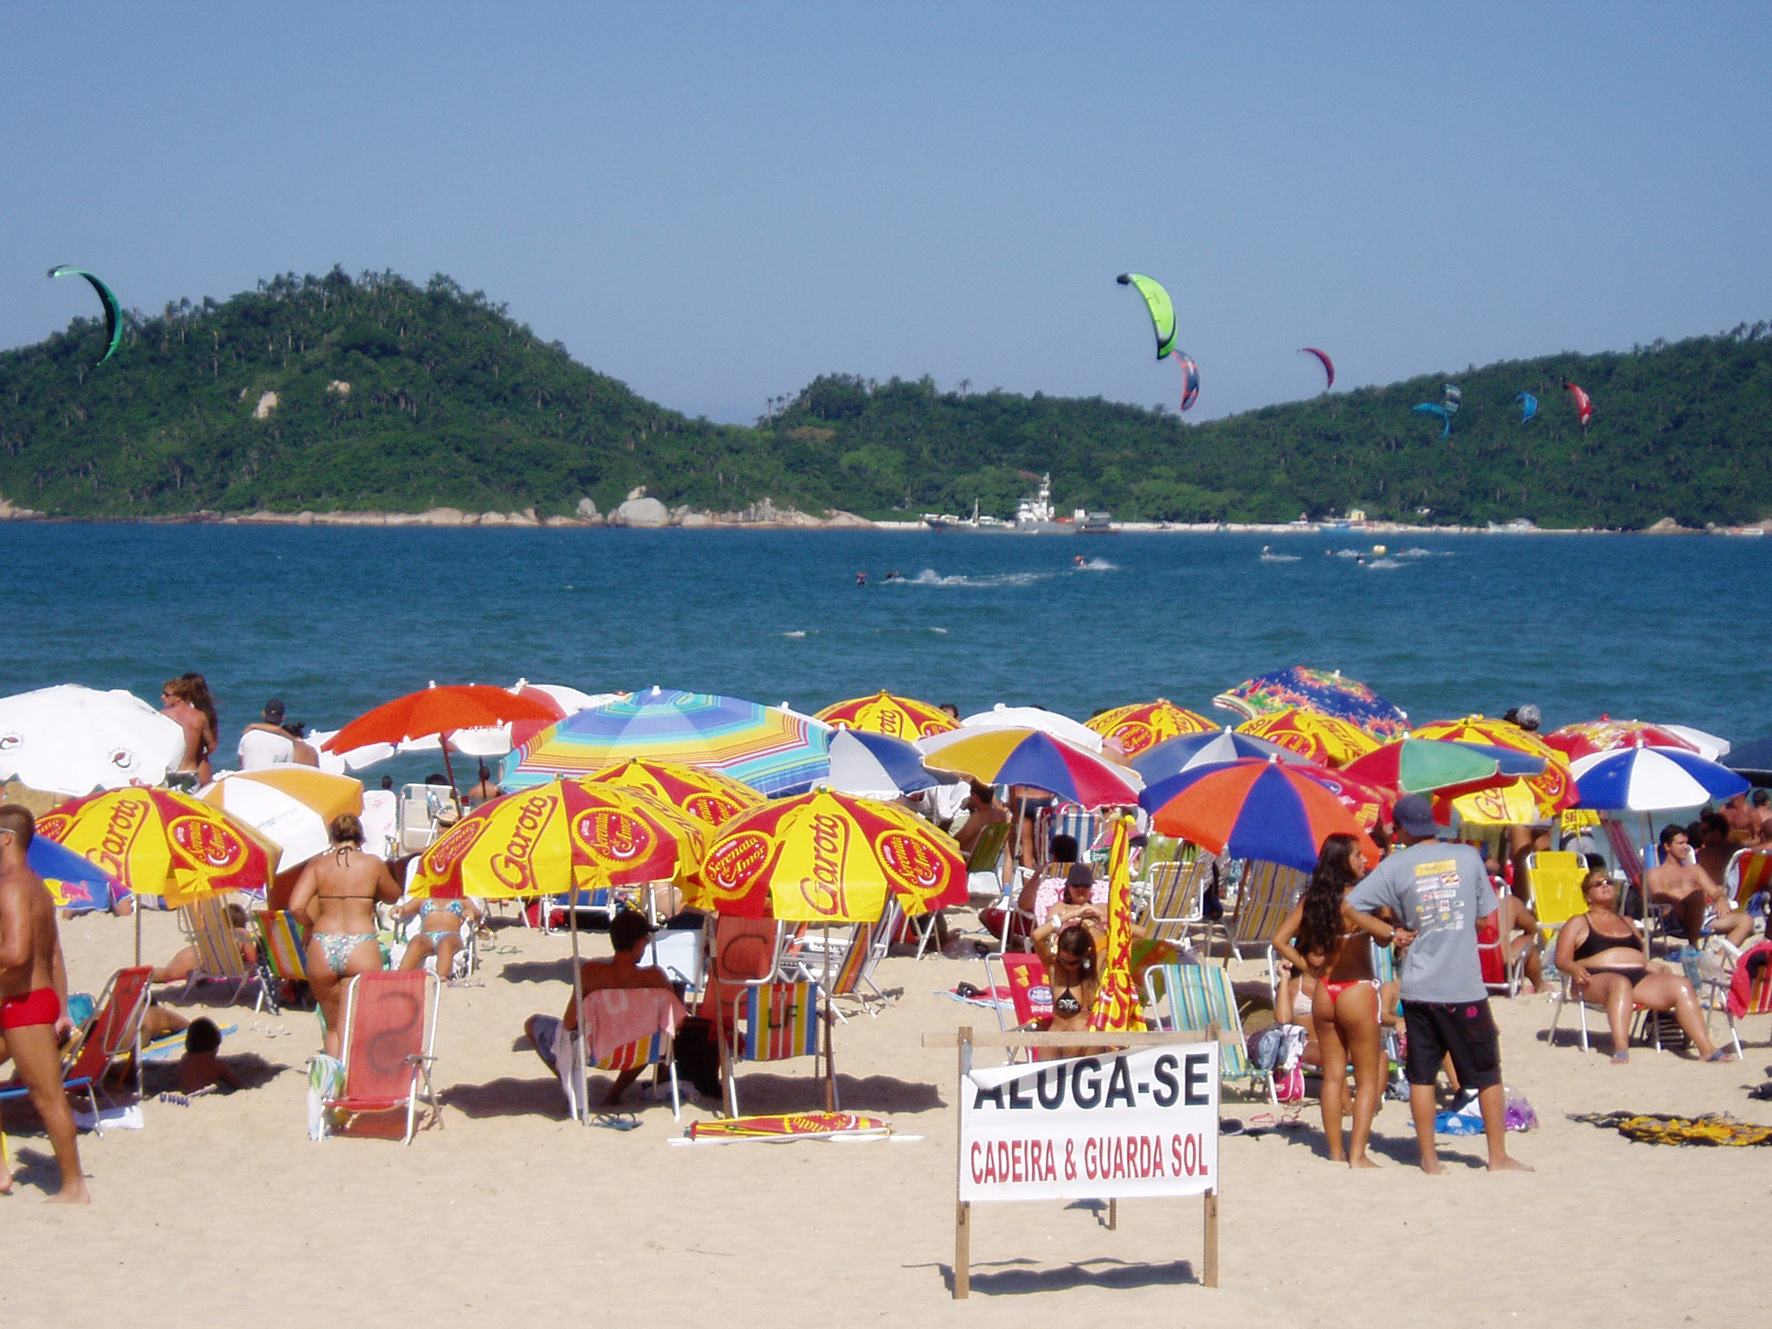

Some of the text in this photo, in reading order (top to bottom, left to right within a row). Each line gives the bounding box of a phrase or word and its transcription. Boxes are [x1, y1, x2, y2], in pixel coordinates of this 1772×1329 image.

[490, 795, 550, 890] Garoto
[708, 836, 759, 880] Serenata
[726, 845, 765, 882] Amor
[800, 813, 840, 916] Garoto
[973, 1053, 1210, 1110] ALUGA-SE
[971, 1132, 1208, 1185] CADEIRA & GUARDA SOL
